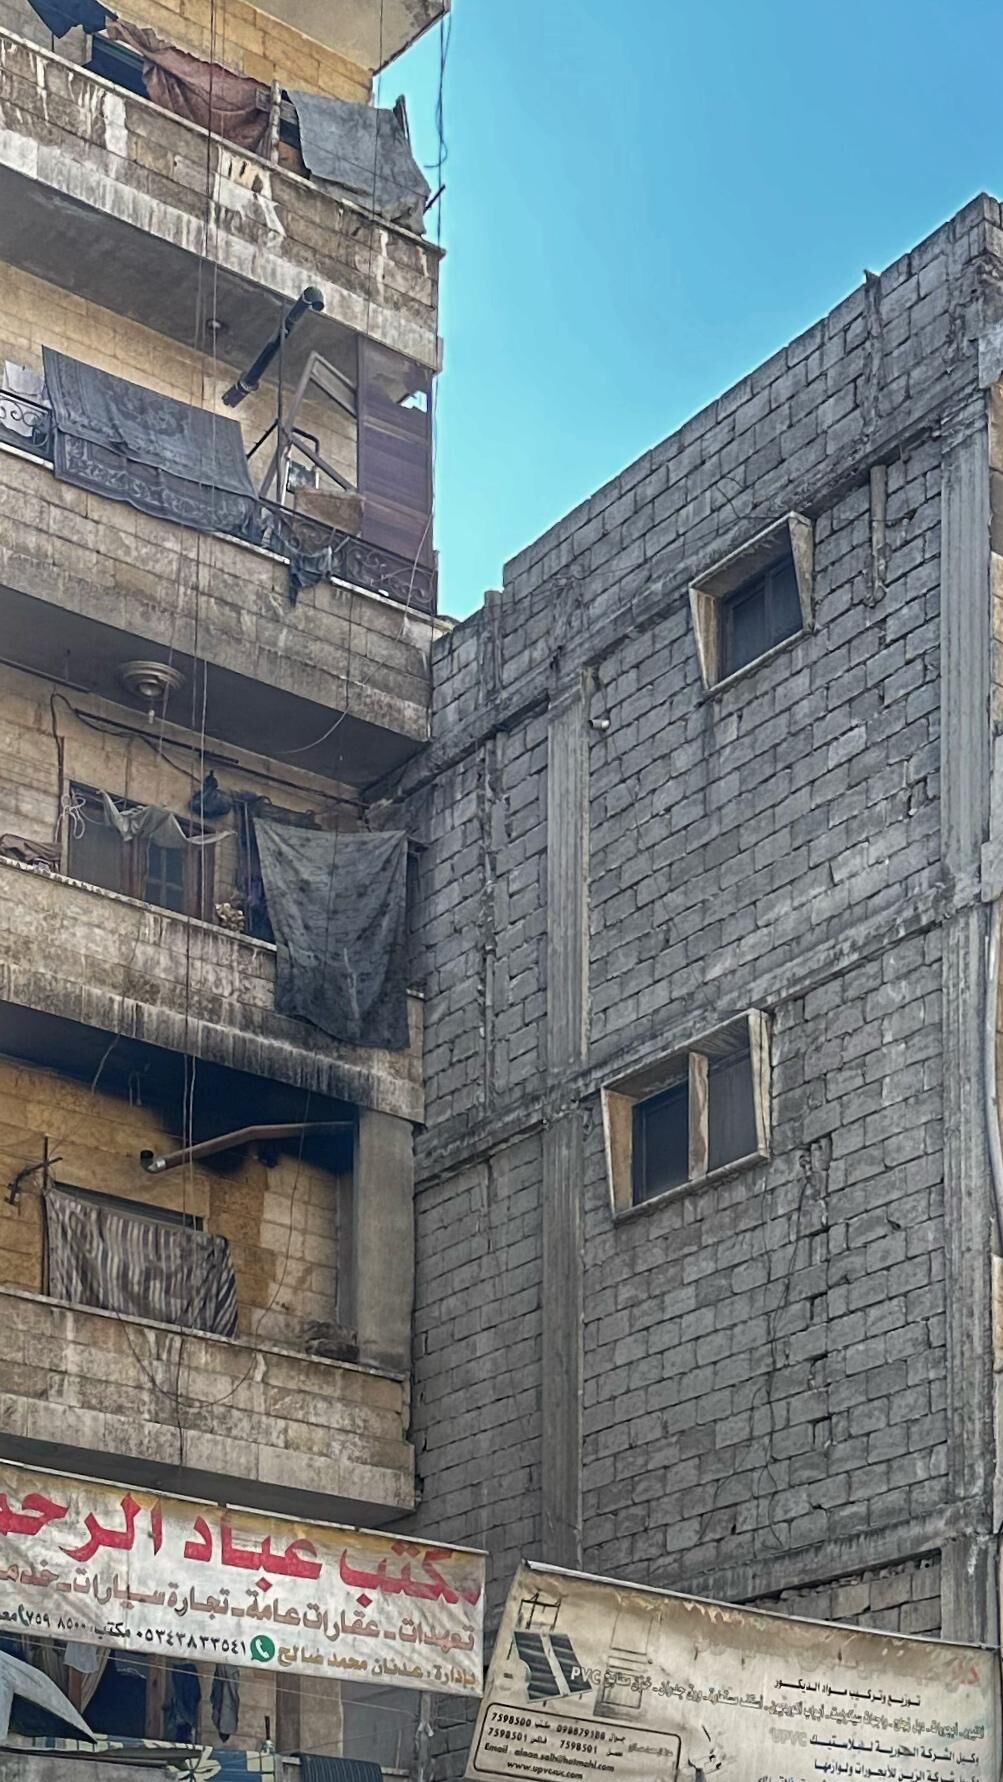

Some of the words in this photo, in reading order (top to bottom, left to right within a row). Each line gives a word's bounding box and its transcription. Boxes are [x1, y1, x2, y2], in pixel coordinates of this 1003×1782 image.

[183, 1512, 323, 1593] عباد
[73, 1567, 165, 1610] سيارات
[167, 1582, 230, 1619] تجارة
[246, 1588, 301, 1625] عامة
[303, 1602, 381, 1641] عقارات
[400, 1618, 475, 1654] تعهدات
[328, 1651, 368, 1670] محمد
[571, 1665, 602, 1684] PVC
[490, 1712, 532, 1728] 7598500
